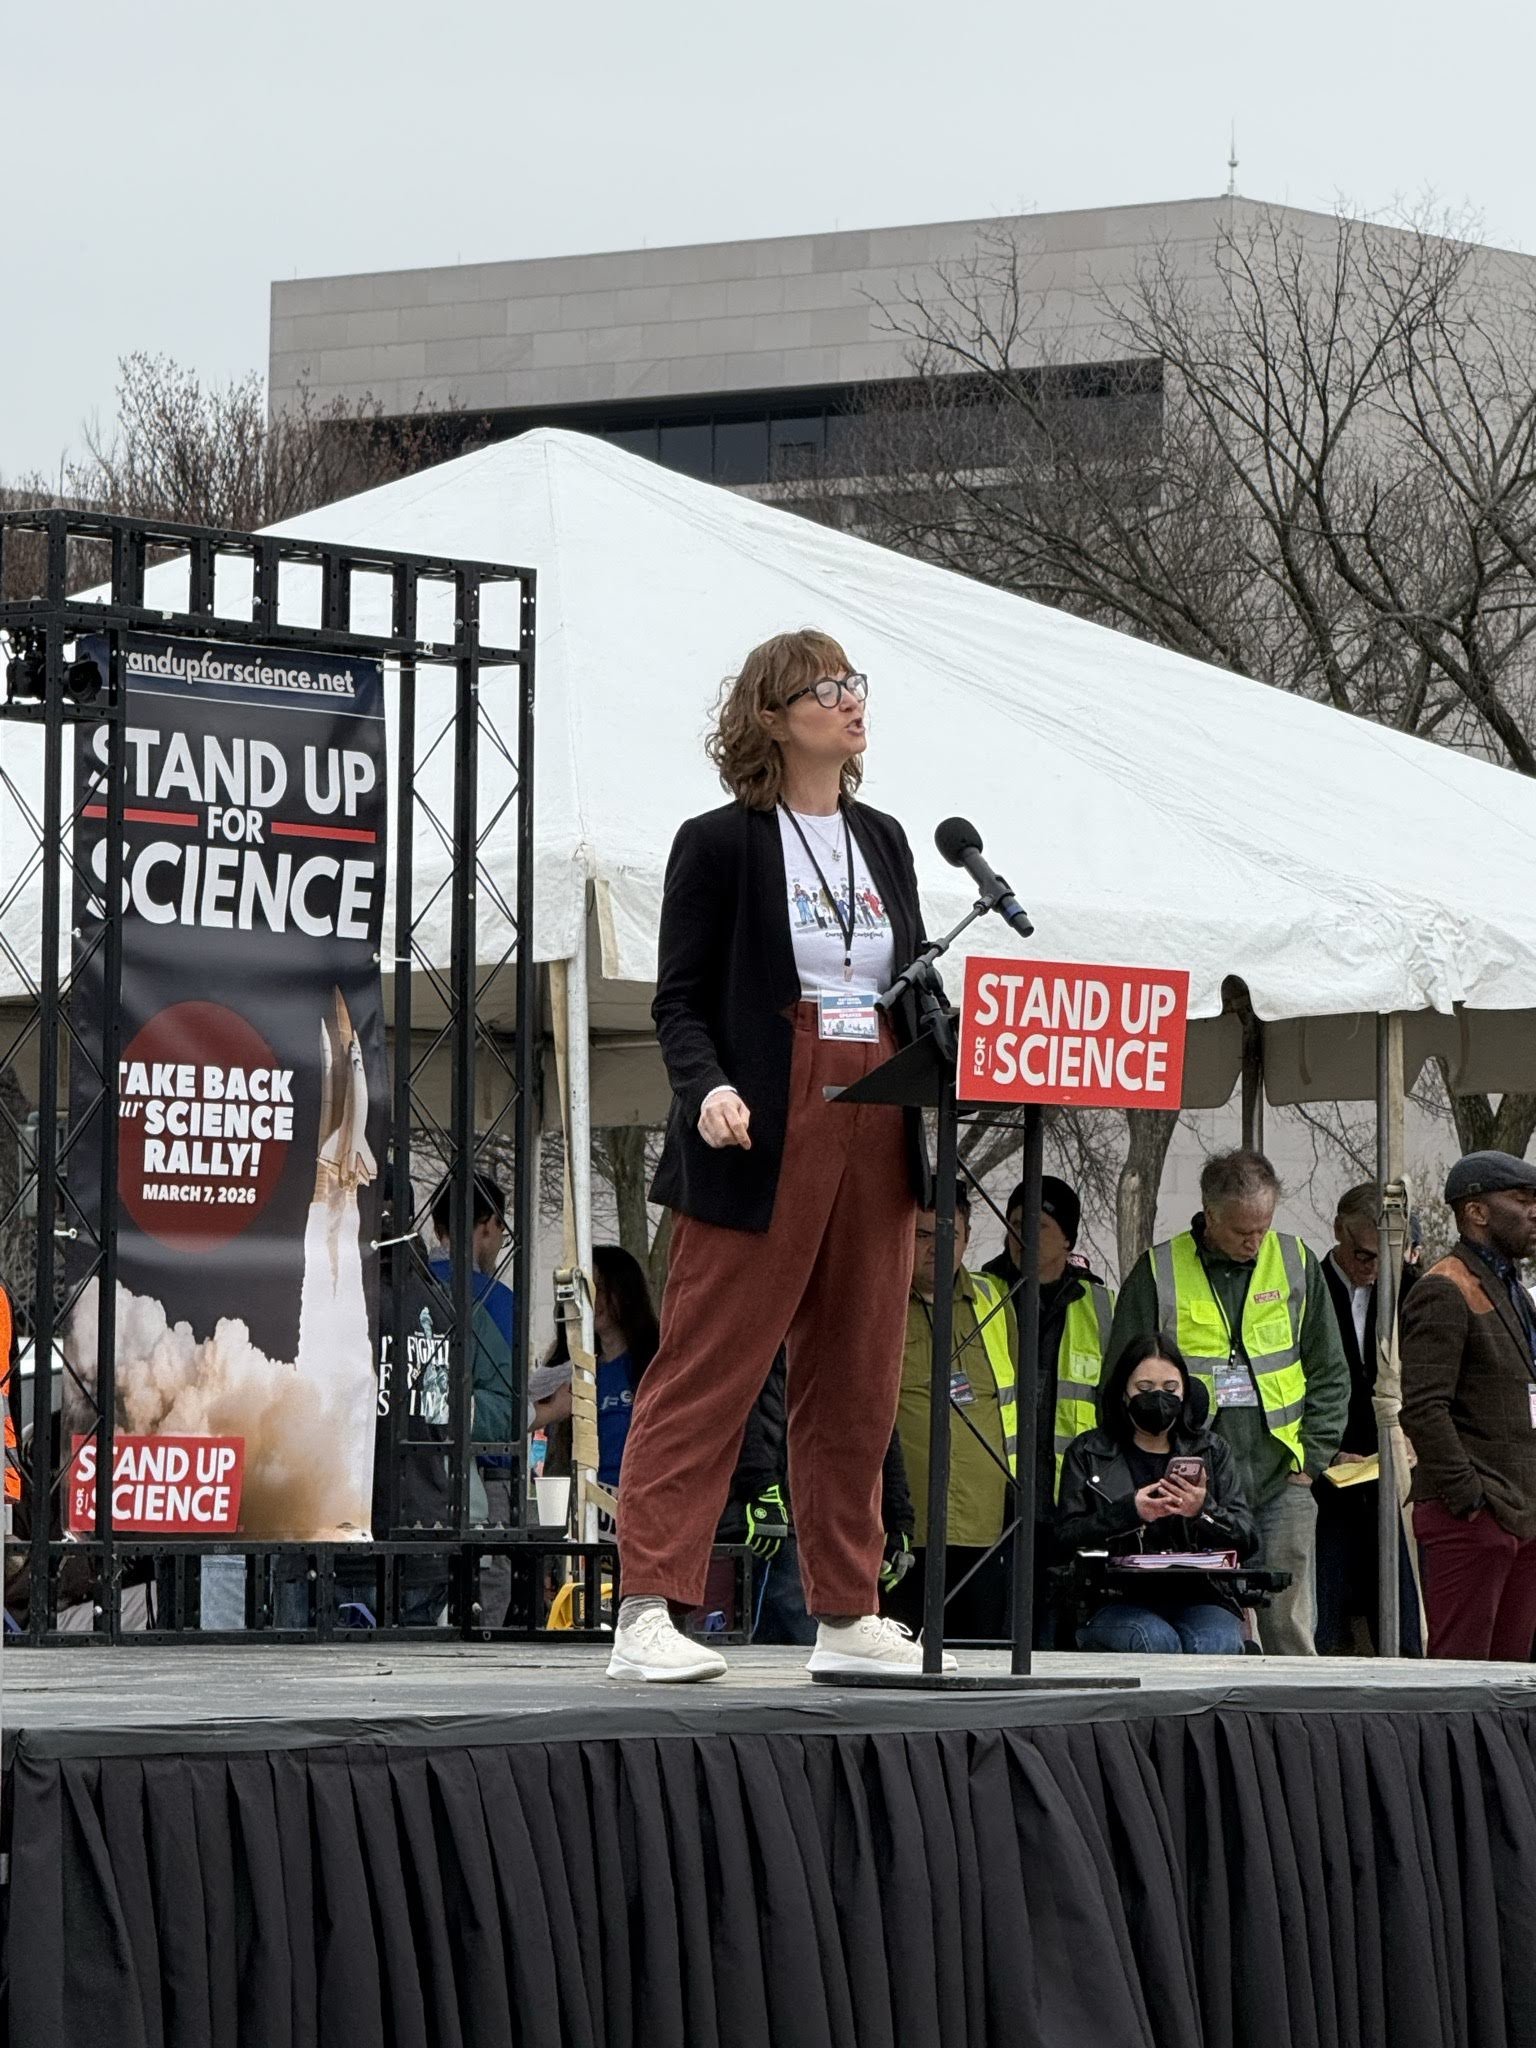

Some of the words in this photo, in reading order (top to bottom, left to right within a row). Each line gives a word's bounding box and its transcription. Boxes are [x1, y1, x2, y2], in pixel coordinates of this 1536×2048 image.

[125, 646, 355, 695] andupforscience.net
[304, 745, 376, 817] UP
[207, 806, 264, 844] FOR
[86, 837, 375, 939] SCIENCE
[974, 973, 1111, 1031] STAND
[1121, 982, 1176, 1035] UP
[973, 1036, 986, 1076] FOR
[992, 1032, 1168, 1092] SCIENCE
[203, 1065, 294, 1103] BACK
[119, 1101, 143, 1118] ur
[144, 1100, 294, 1141] SCIENCE
[144, 1139, 261, 1177] RALLY!
[143, 1184, 201, 1202] MARCH
[204, 1186, 215, 1204] 7,
[217, 1187, 256, 1204] 2026
[76, 1445, 190, 1483] SAND
[196, 1447, 236, 1483] UP
[75, 1487, 85, 1516] FOR
